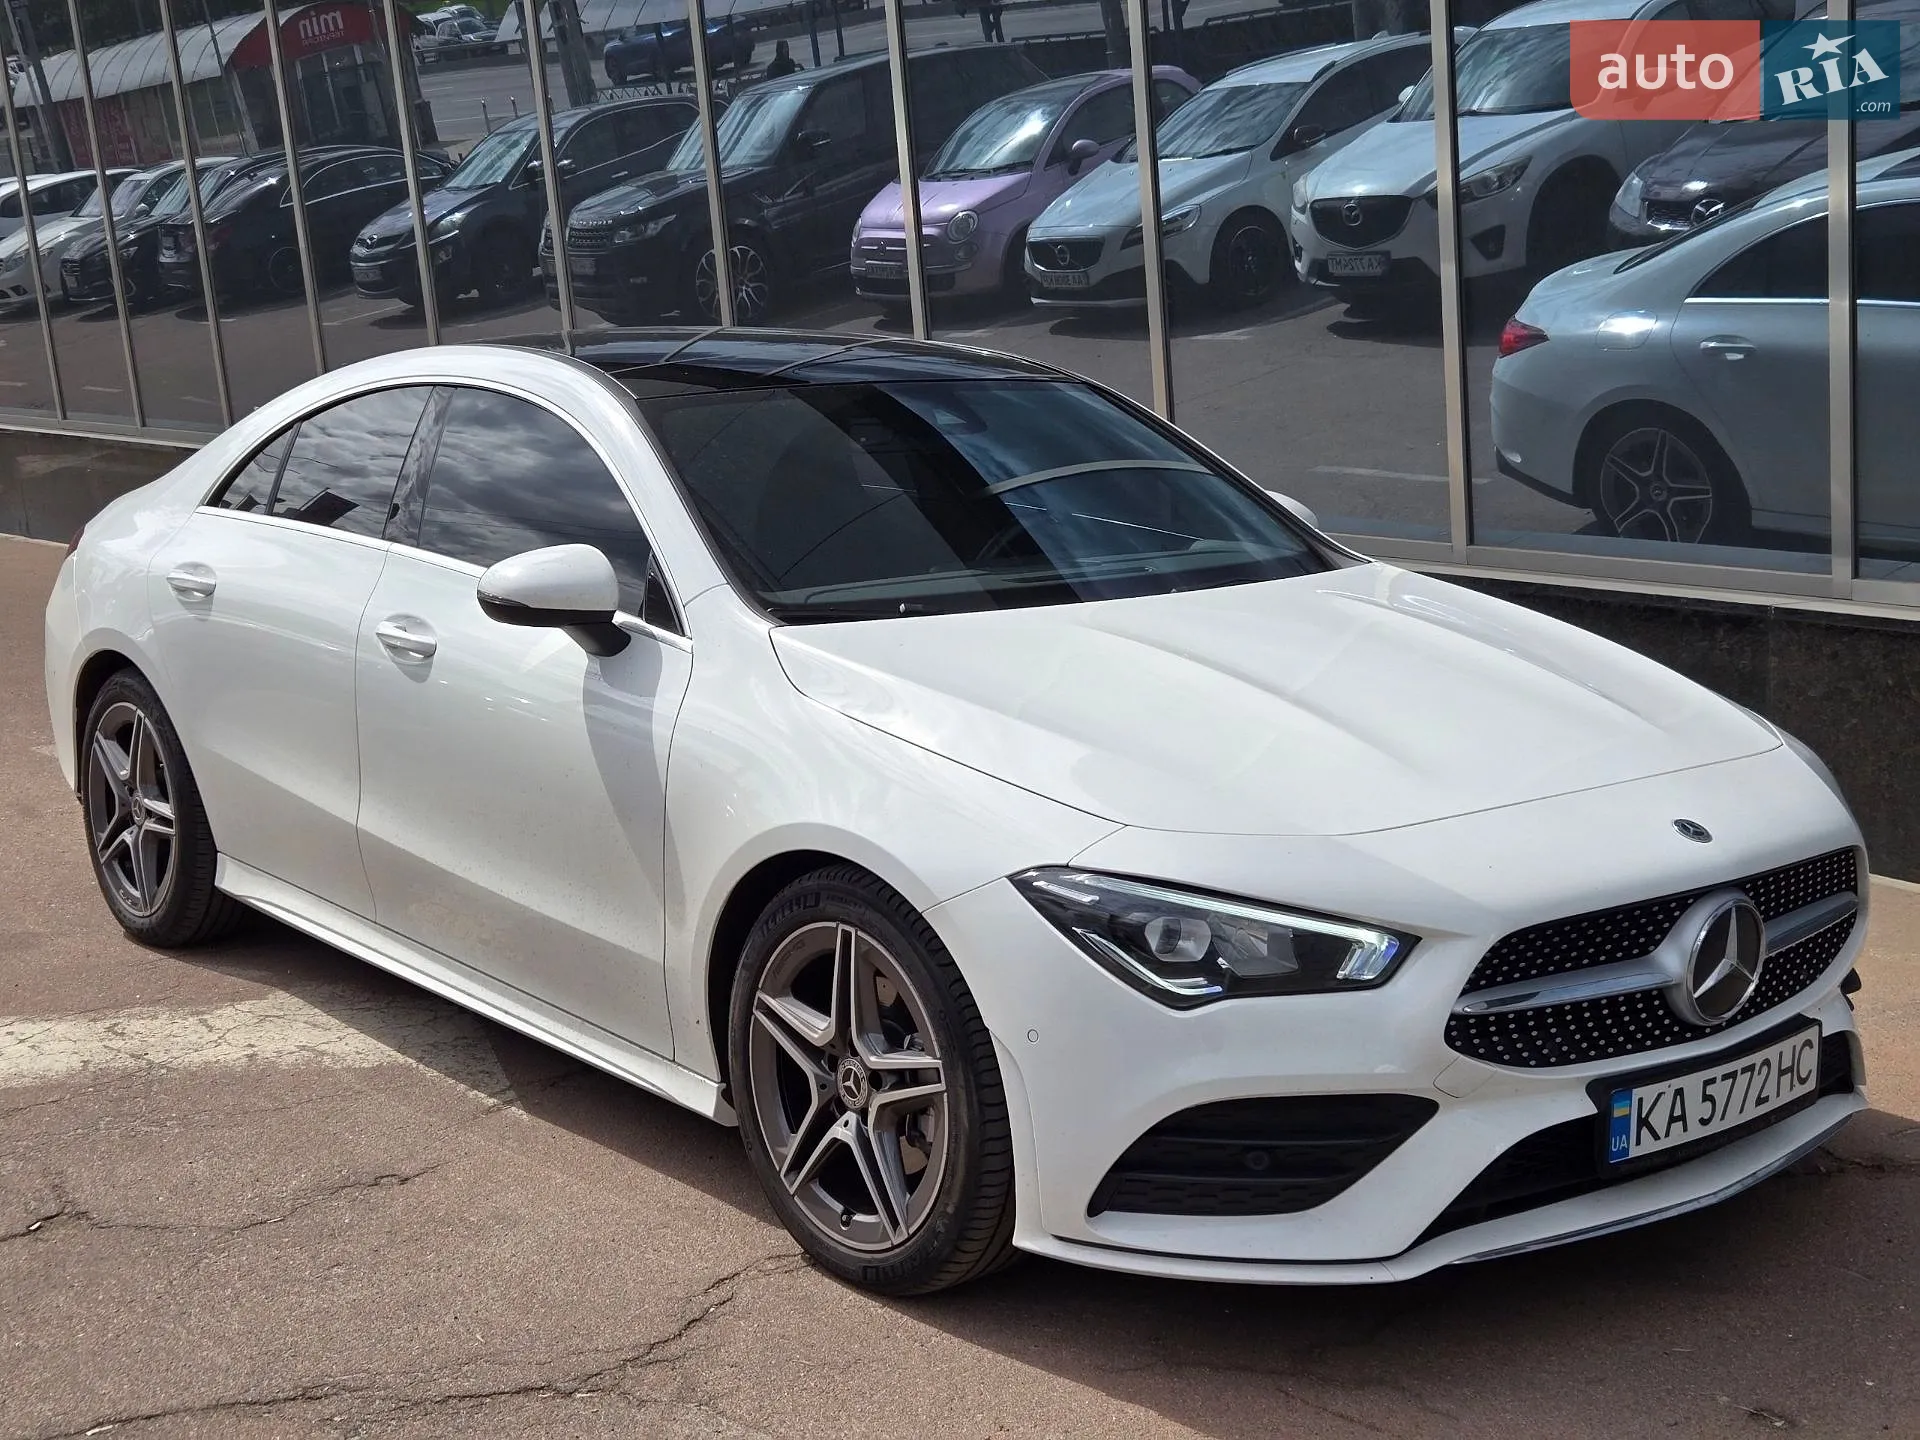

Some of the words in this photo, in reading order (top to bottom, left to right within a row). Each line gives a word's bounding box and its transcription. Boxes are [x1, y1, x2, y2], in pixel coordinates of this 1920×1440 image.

[1635, 1086, 1689, 1146] KA
[1698, 1057, 1772, 1127] 5772
[1775, 1038, 1814, 1099] HC
[1611, 1136, 1629, 1152] UA
